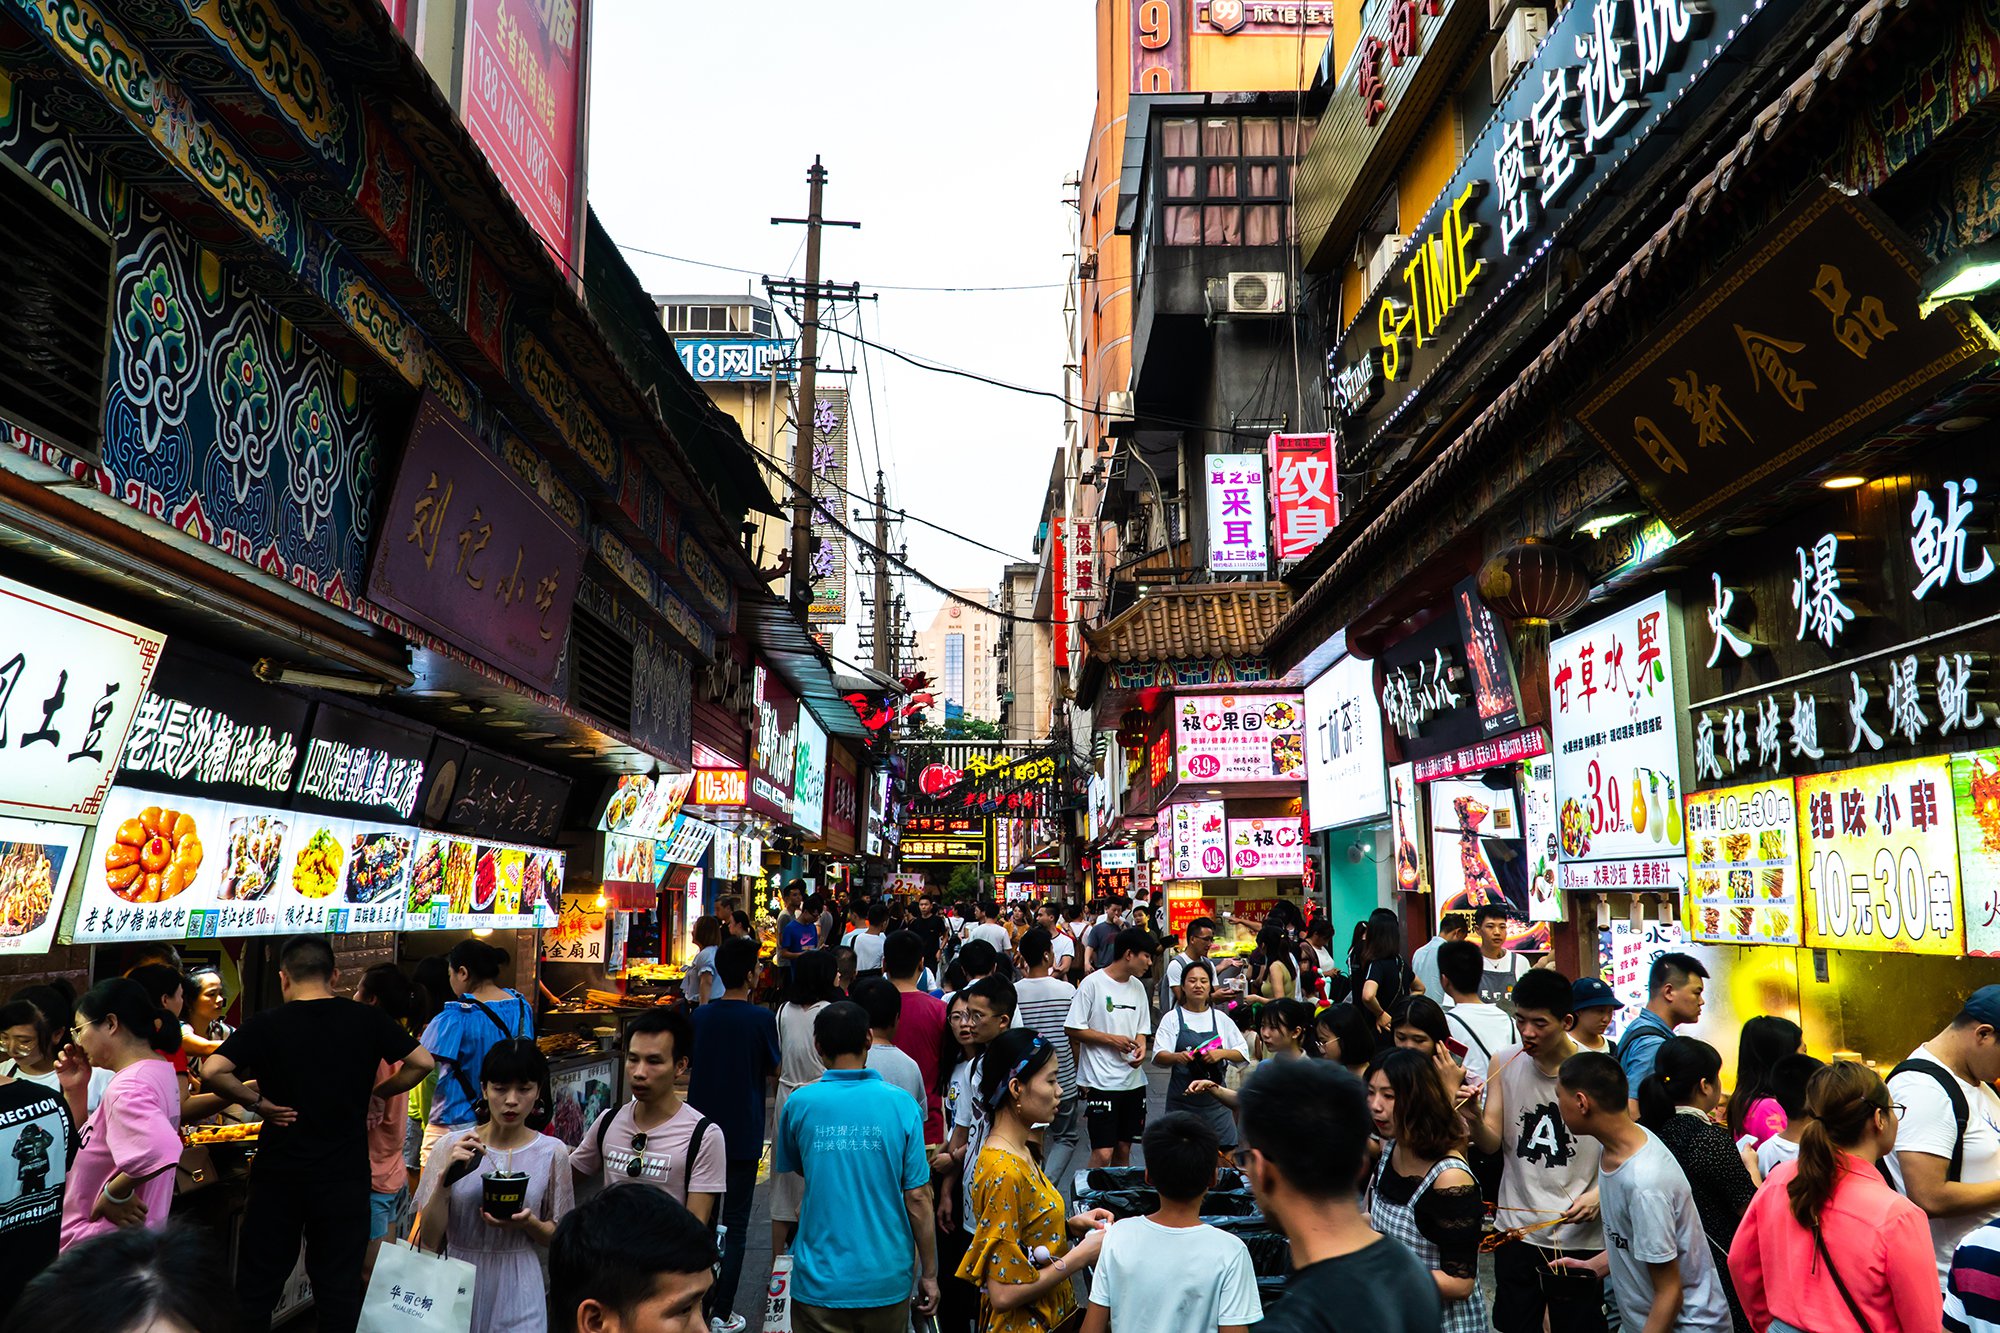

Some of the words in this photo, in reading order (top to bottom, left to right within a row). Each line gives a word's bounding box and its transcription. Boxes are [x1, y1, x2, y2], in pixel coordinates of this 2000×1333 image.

[495, 3, 556, 141] 全省招商热线
[478, 45, 498, 112] 188
[499, 80, 524, 157] 7401
[526, 130, 550, 198] 0881
[1379, 183, 1483, 382] S-TIME
[1222, 488, 1253, 548] 采耳
[1278, 457, 1331, 553] 纹身
[407, 470, 559, 641] 刘记小吃
[1212, 550, 1257, 561] 请上三楼
[1706, 478, 1995, 668] 火爆鱿
[1554, 612, 1661, 714] 甘草水果
[1696, 691, 1824, 782] 疯狂烤翅
[1849, 654, 2000, 753] 火爆鱿
[1588, 759, 1621, 835] 3.9
[1809, 779, 1938, 839] 绝味小串
[687, 882, 698, 898] 果
[1593, 865, 1628, 887] 水果沙拉
[1632, 861, 1671, 886] 免费榨汁
[1808, 846, 1955, 941] 10元30串
[813, 1139, 882, 1151] 中装领先未来
[815, 1125, 882, 1138] 科技提升装饰
[1530, 1113, 1558, 1156] A
